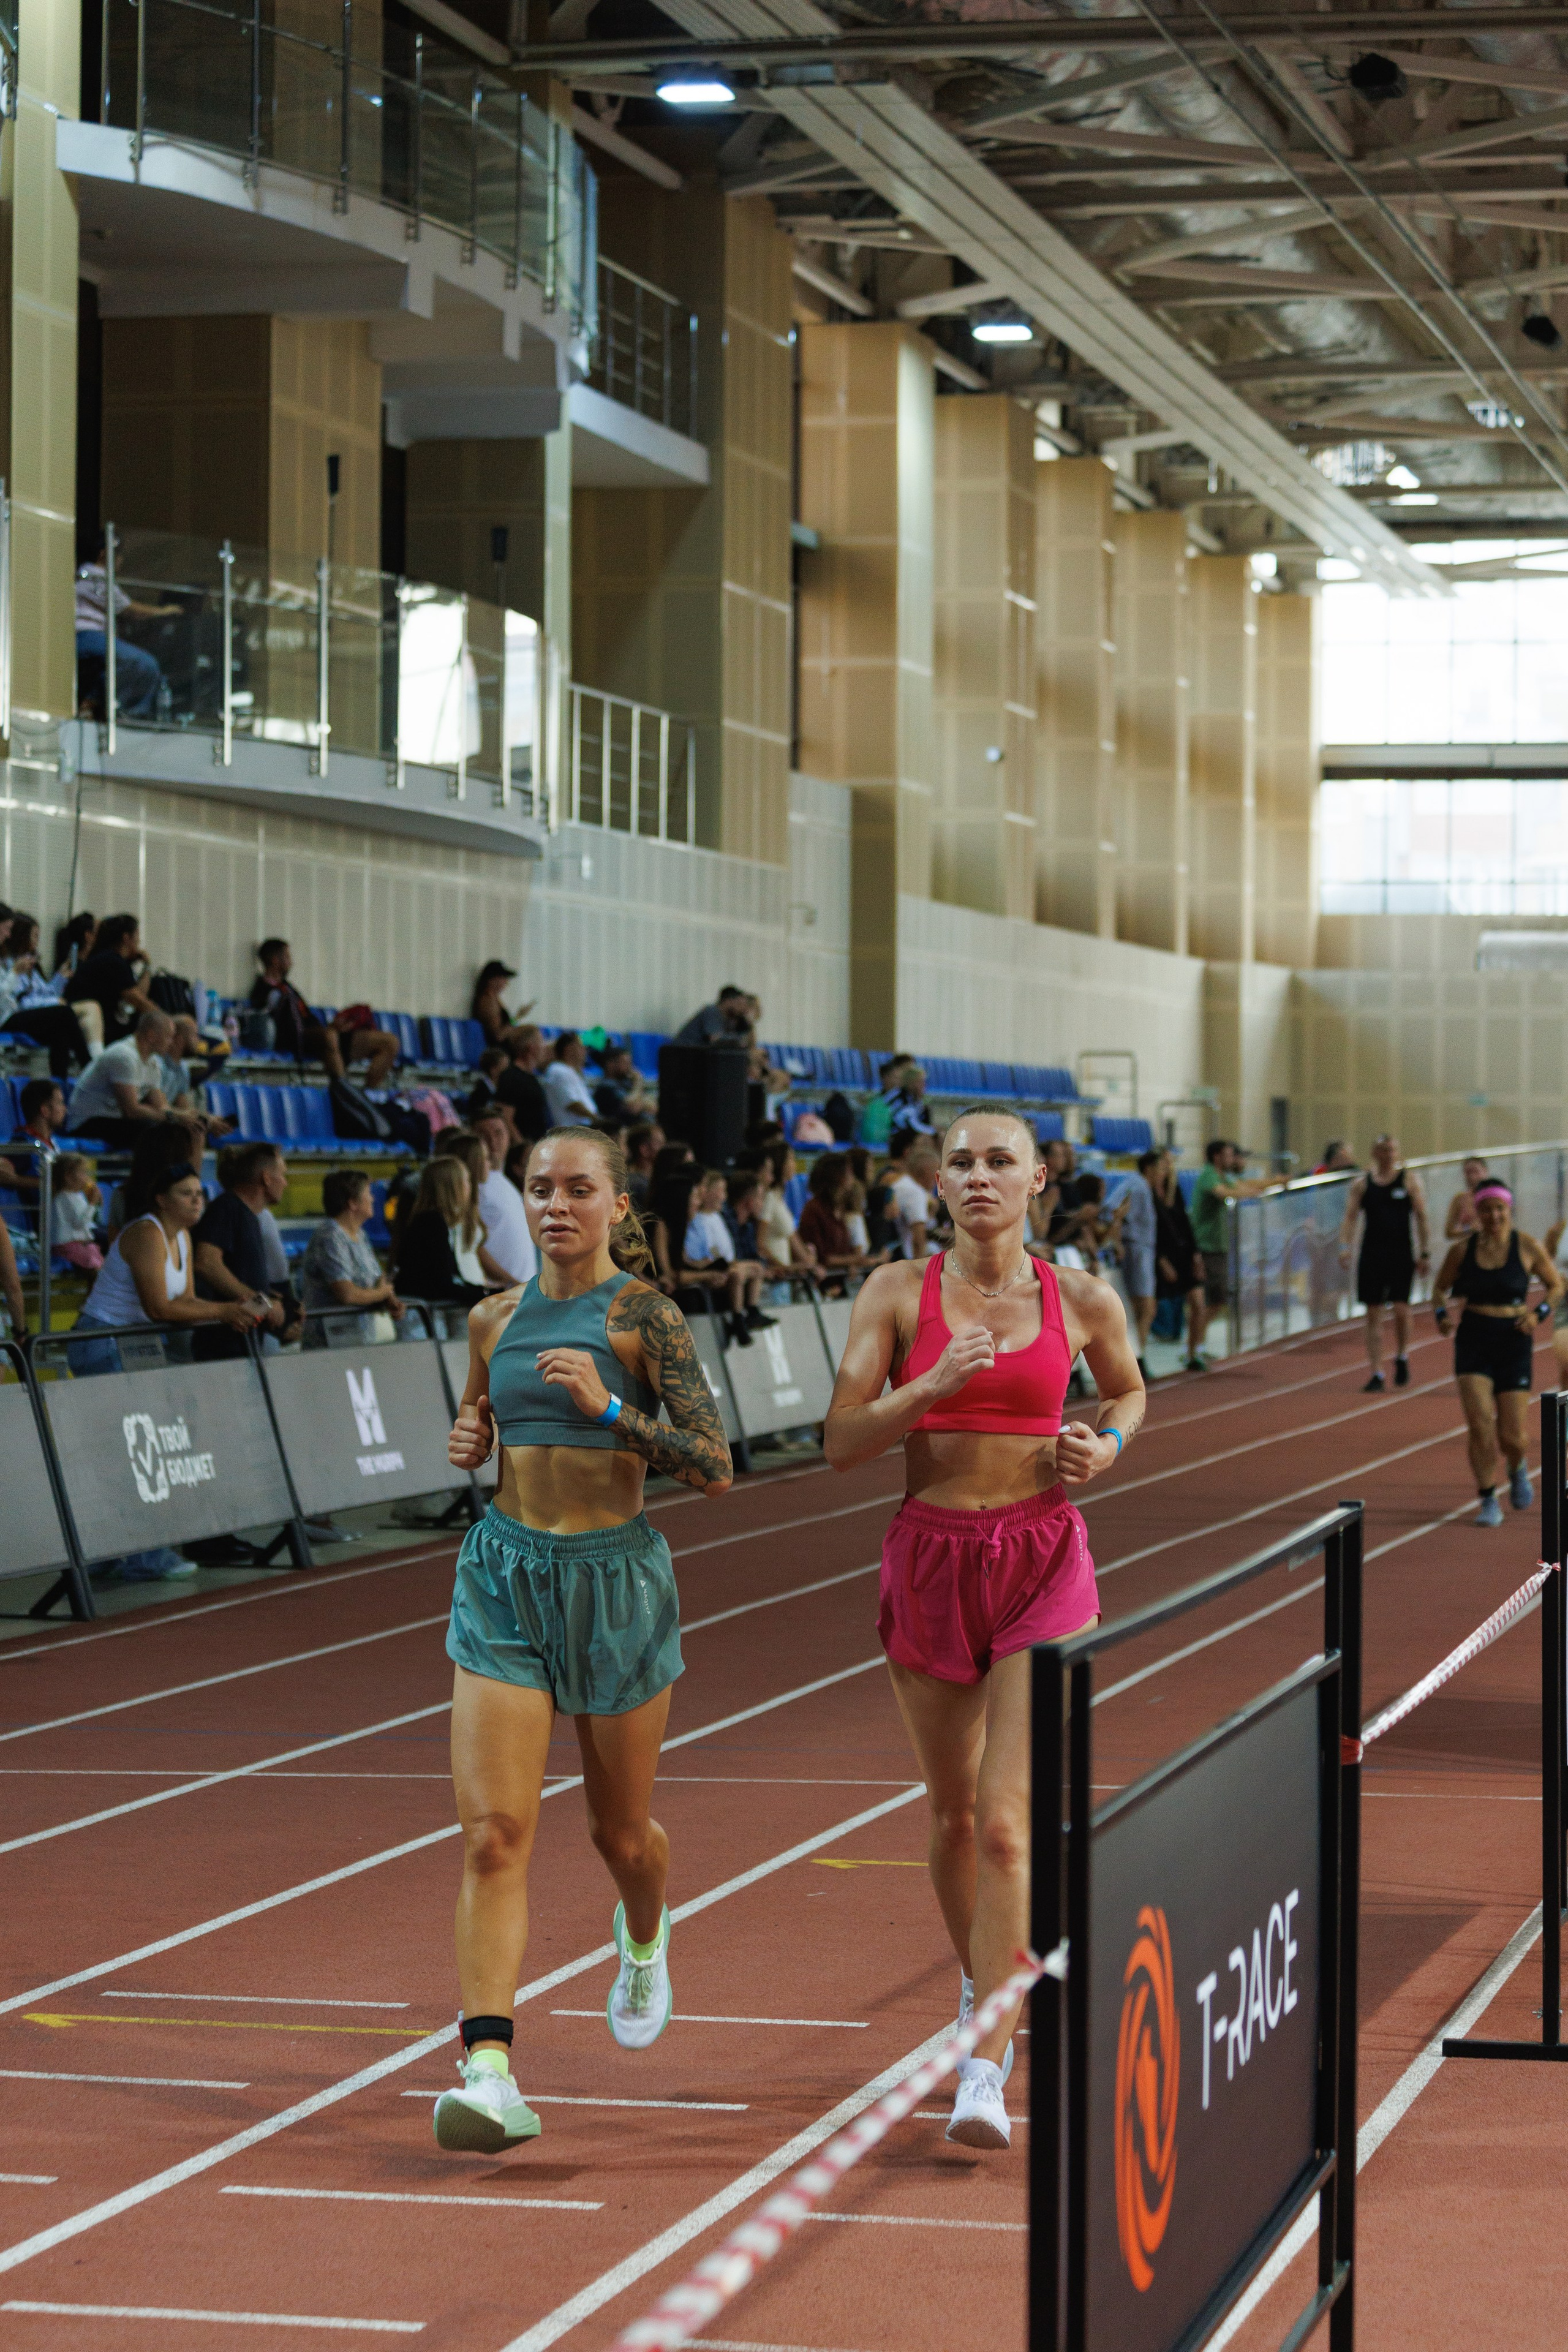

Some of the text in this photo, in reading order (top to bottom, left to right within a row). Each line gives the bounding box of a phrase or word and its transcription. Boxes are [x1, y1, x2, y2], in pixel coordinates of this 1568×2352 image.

[157, 1416, 192, 1452] ТВОЙ
[166, 1453, 216, 1488] БЮДЖЕТ
[1196, 1888, 1298, 2110] T-RACE
